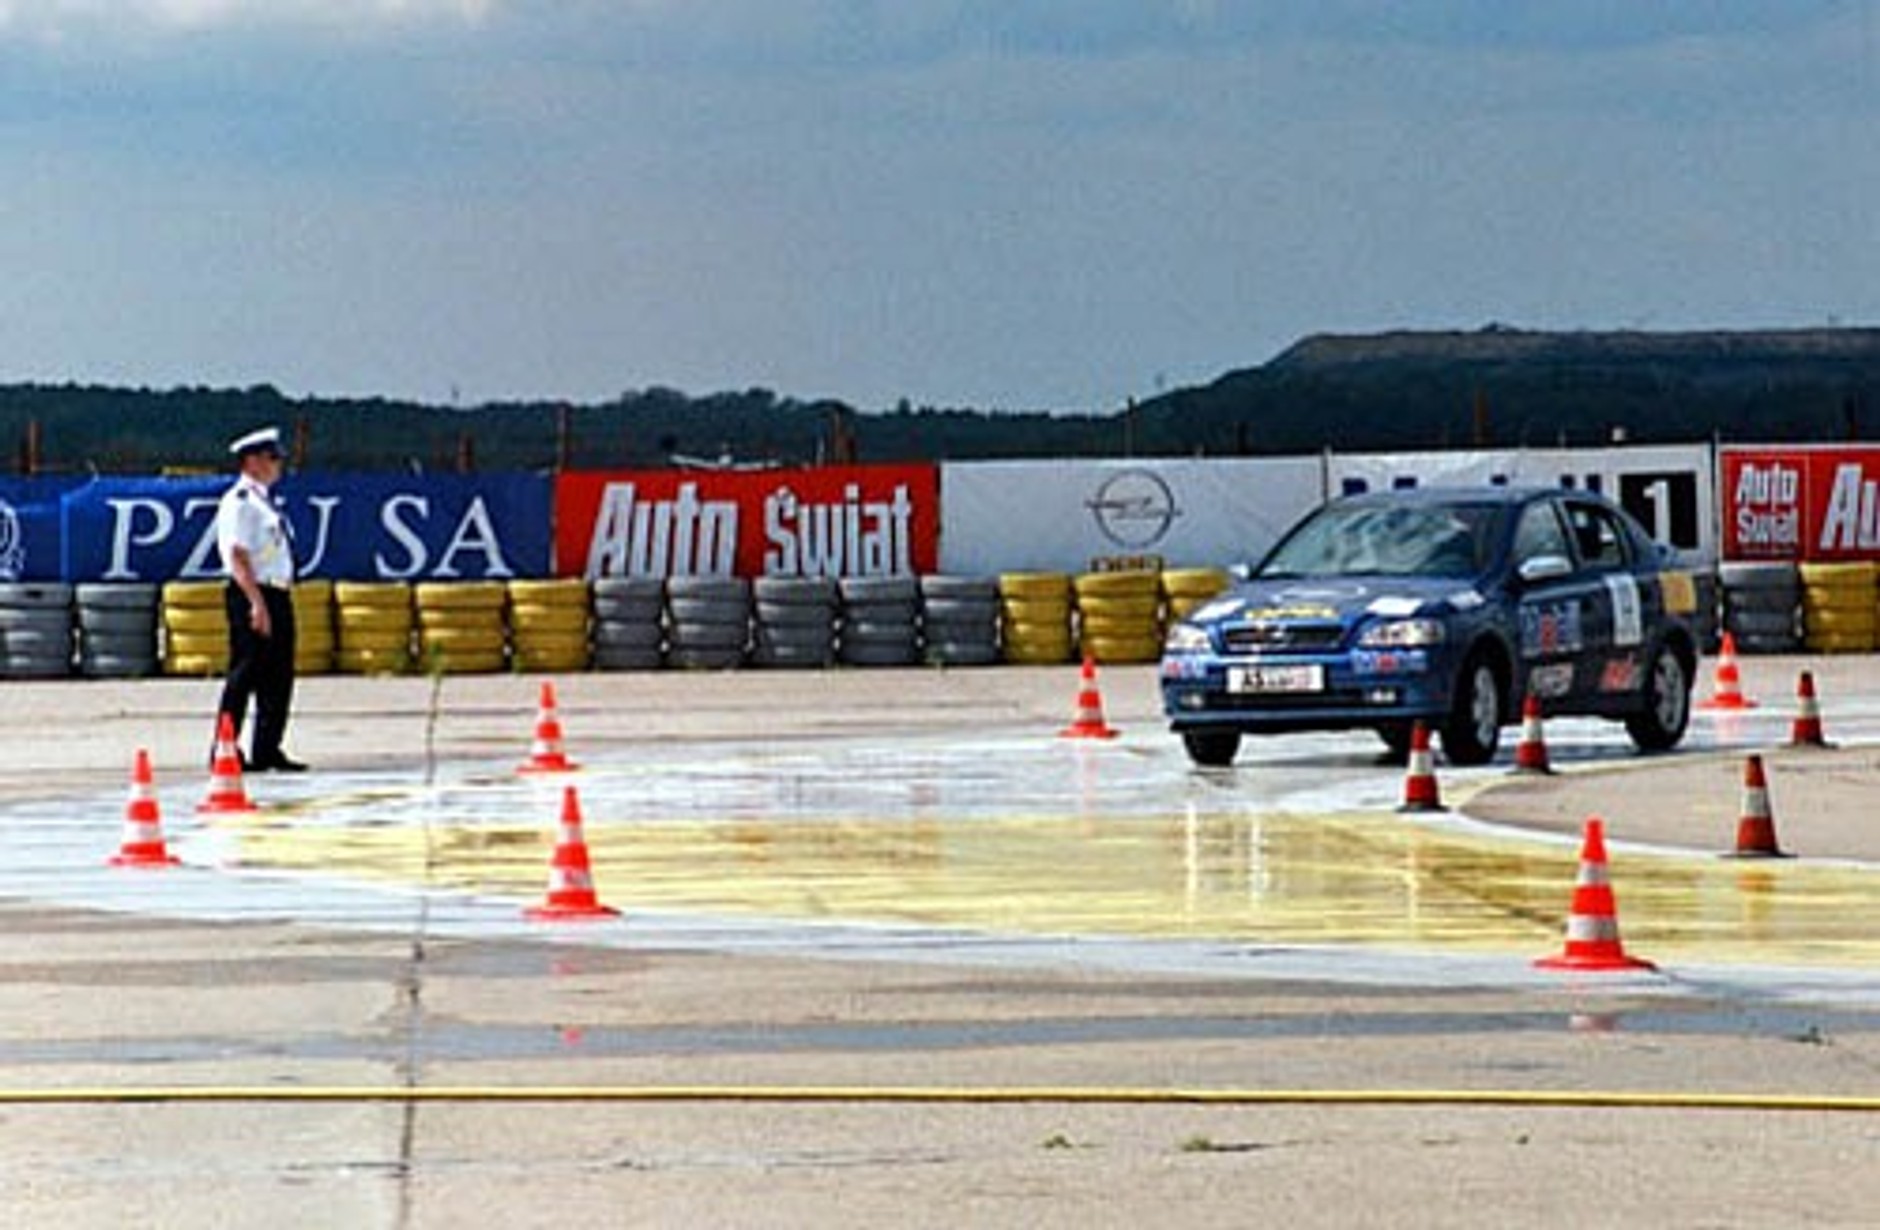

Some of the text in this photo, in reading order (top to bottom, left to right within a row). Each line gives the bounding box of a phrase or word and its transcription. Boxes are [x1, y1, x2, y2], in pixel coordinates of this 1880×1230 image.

[1736, 463, 1798, 504] Auto
[374, 496, 514, 578] SA
[587, 481, 738, 578] Auto
